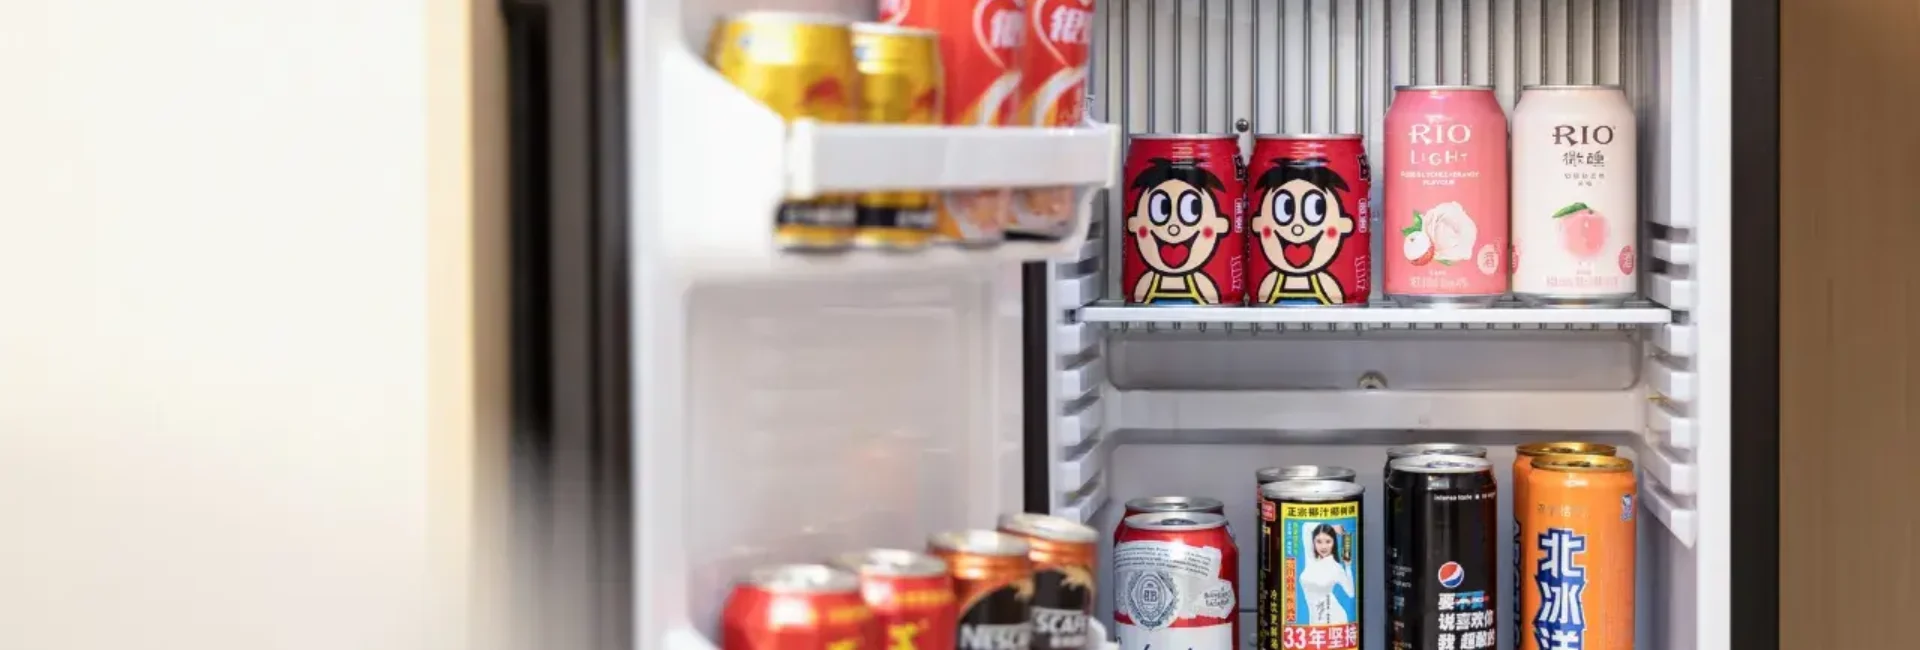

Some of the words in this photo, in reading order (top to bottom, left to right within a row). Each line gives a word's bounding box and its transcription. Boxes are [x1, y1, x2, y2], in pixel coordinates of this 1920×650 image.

[1408, 123, 1471, 145] RIO
[1552, 125, 1614, 146] RIO
[1411, 149, 1468, 166] LIGHT
